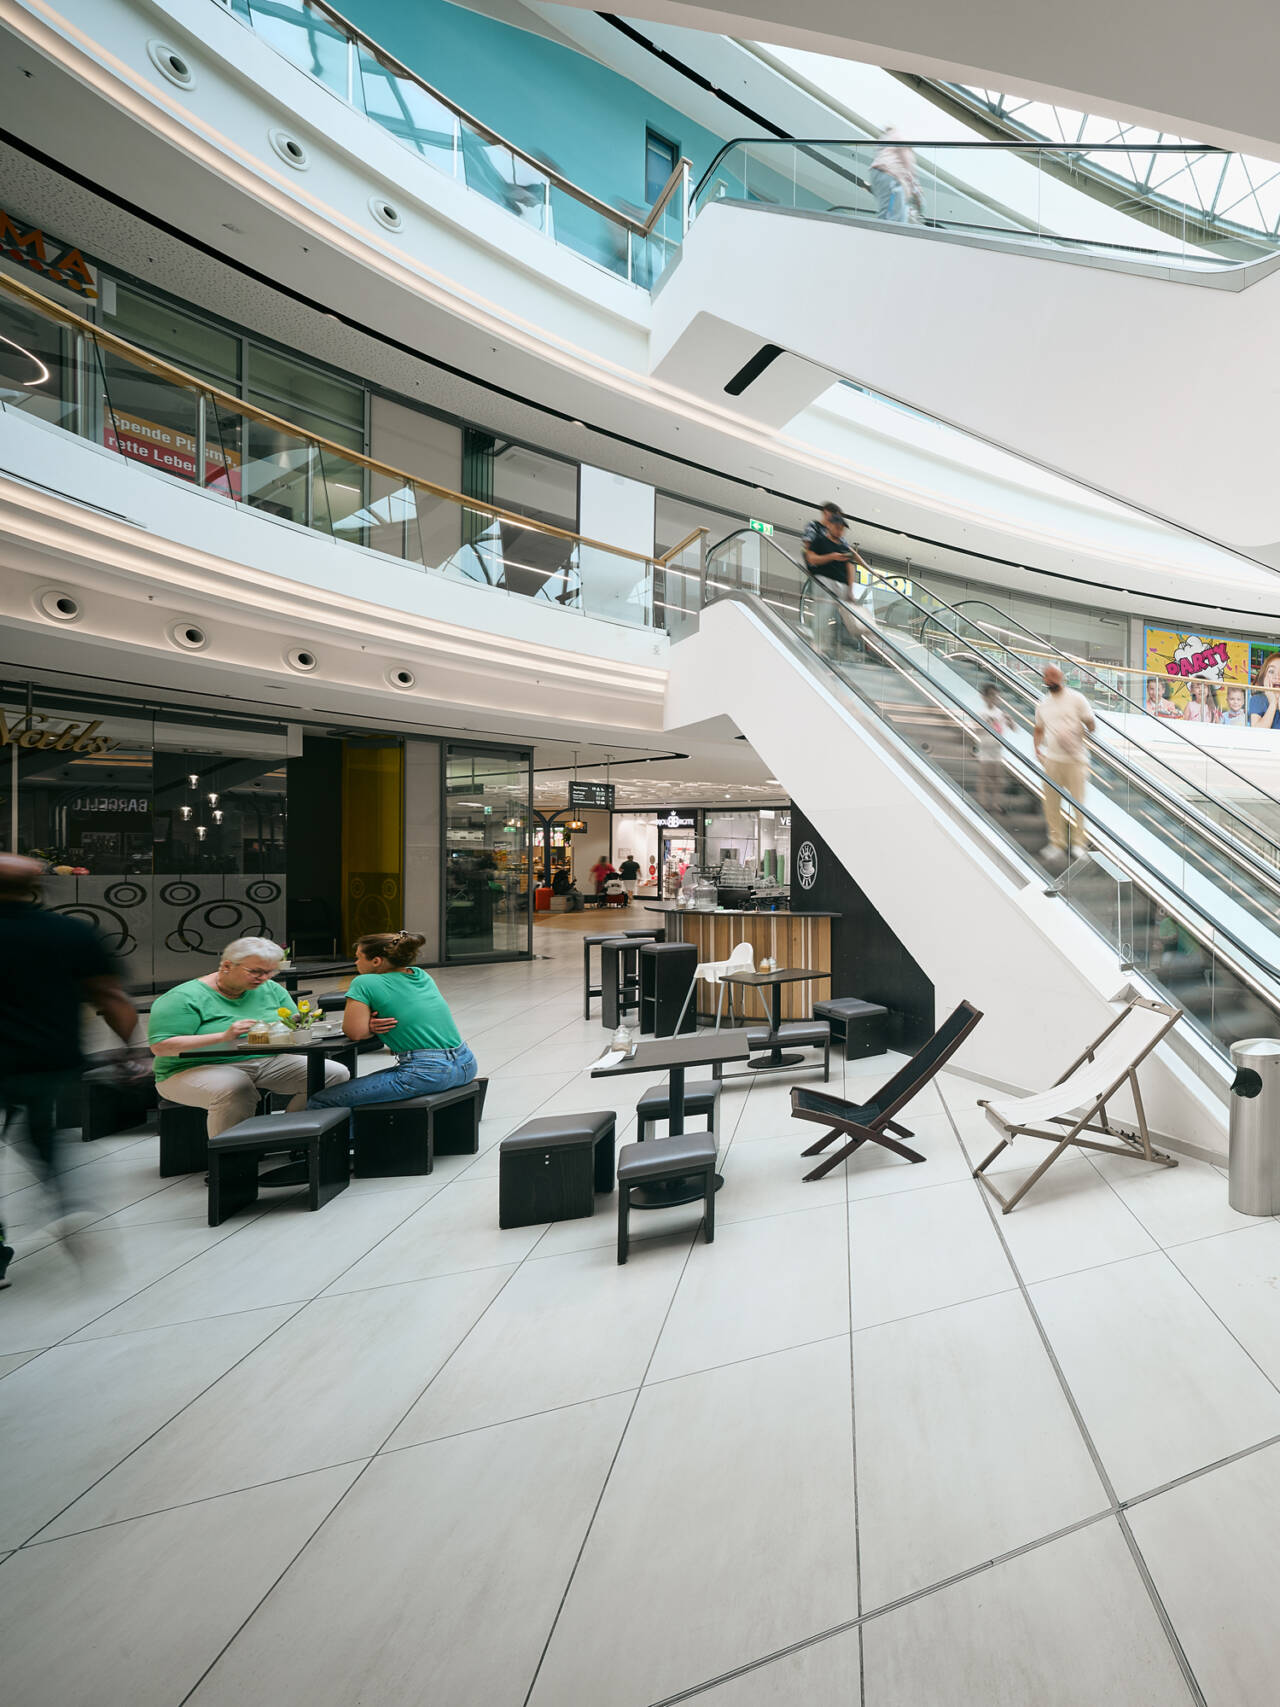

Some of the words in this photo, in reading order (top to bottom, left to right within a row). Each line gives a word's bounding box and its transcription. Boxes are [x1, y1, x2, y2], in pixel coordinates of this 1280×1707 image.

[108, 413, 171, 443] Spende
[108, 441, 149, 457] rette
[1165, 643, 1229, 677] PARTY
